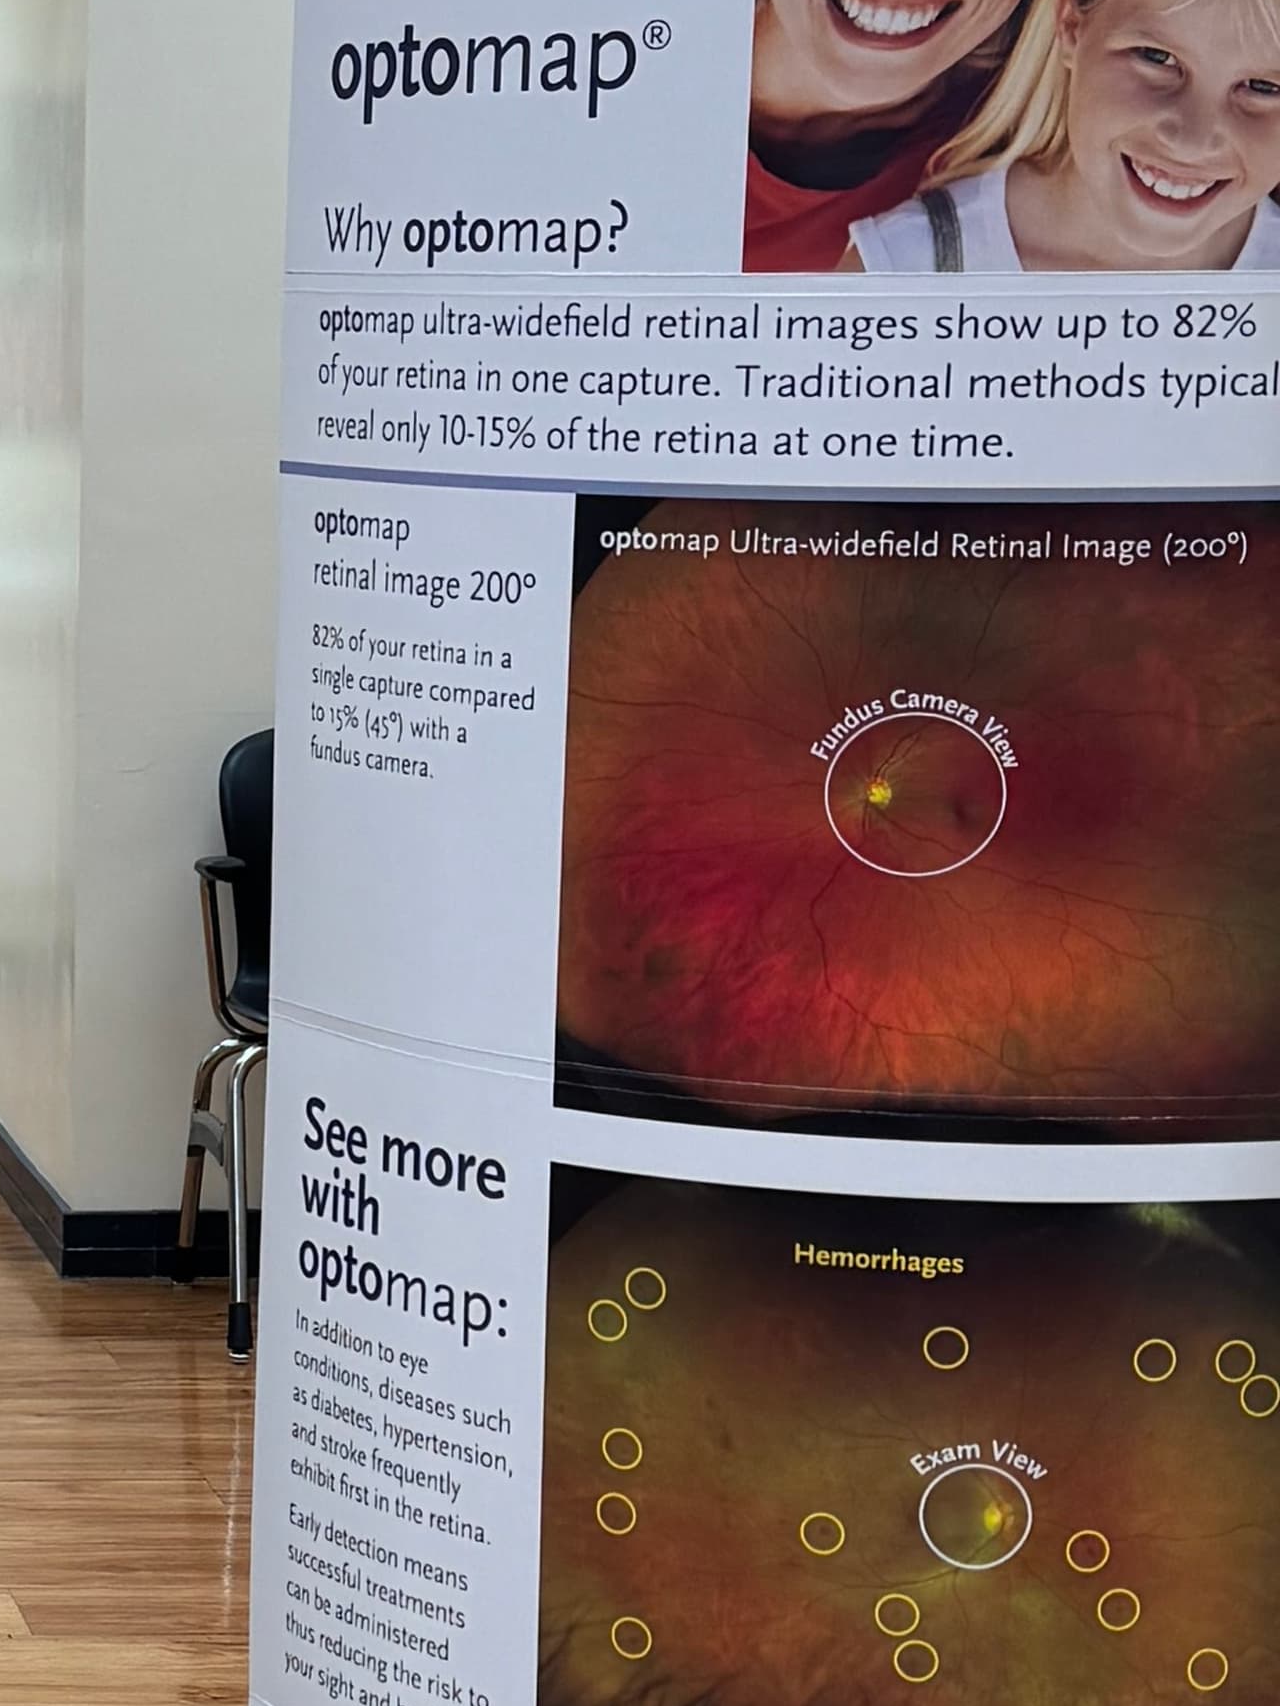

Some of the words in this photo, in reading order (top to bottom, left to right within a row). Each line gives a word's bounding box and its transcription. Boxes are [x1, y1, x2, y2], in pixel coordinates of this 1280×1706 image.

[330, 17, 672, 125] optomap®
[325, 204, 392, 268] Why
[402, 199, 629, 269] optomap?
[320, 307, 414, 344] optomap
[423, 302, 631, 340] ultra-widefield
[644, 303, 759, 340] retinal
[775, 305, 919, 350] images
[935, 303, 1041, 340] show
[1057, 313, 1107, 350] up
[1121, 308, 1159, 340] to
[1173, 302, 1257, 340] 82%
[318, 352, 341, 386] of
[341, 363, 388, 395] your
[395, 359, 466, 392] retina
[477, 361, 502, 392] in
[511, 367, 568, 394] one
[579, 367, 721, 405] capture.
[735, 363, 952, 399] Traditional
[969, 362, 1146, 399] methods
[317, 409, 374, 441] reveal
[381, 410, 430, 453] only
[440, 414, 536, 450] 10-15%
[547, 416, 582, 450] of
[588, 417, 640, 452] the
[653, 422, 757, 455] retina
[773, 430, 809, 456] at
[822, 431, 897, 457] one
[911, 426, 1014, 457] time.
[314, 509, 410, 550] optomap
[599, 527, 719, 559] optomap
[730, 529, 938, 558] Ultra-widefield
[952, 531, 1050, 559] Retinal
[1063, 533, 1151, 566] Image
[313, 559, 376, 591] retinal
[384, 566, 460, 608] image
[312, 624, 344, 651] 82%
[348, 630, 364, 653] of
[369, 641, 405, 661] your
[412, 640, 466, 665] retina
[312, 664, 354, 695] single
[359, 677, 423, 700] capture
[429, 686, 535, 713] compared
[311, 701, 325, 725] to
[330, 704, 359, 732] 15%
[410, 716, 449, 741] with
[810, 699, 884, 760] Fundus
[890, 689, 979, 724] Camera
[982, 716, 1018, 768] View
[310, 734, 360, 768] fundus
[366, 751, 434, 779] camera.
[304, 1097, 367, 1164] See
[382, 1134, 506, 1199] more
[302, 1166, 379, 1235] with
[793, 1243, 964, 1279] Hemorrhages
[299, 1240, 507, 1347] optomap:
[296, 1309, 308, 1333] In
[312, 1317, 372, 1357] addition
[378, 1341, 393, 1363] to
[400, 1351, 428, 1376] eye
[294, 1348, 373, 1398] conditions,
[378, 1376, 455, 1418] diseases
[463, 1408, 511, 1435] such
[292, 1422, 316, 1443] and
[321, 1433, 366, 1466] stroke
[372, 1447, 461, 1503] frequently
[311, 1391, 377, 1437] diabetes,
[383, 1415, 513, 1477] hypertension,
[910, 1440, 982, 1478] Exam
[991, 1440, 1049, 1483] View
[340, 1473, 369, 1506] first
[374, 1489, 389, 1512] in
[396, 1497, 422, 1524] the
[430, 1513, 491, 1544] retina.
[290, 1503, 320, 1542] Early
[325, 1522, 398, 1567] detection
[404, 1557, 468, 1591] means
[288, 1544, 361, 1592] successful
[366, 1578, 465, 1628] treatments
[286, 1613, 315, 1642] thus
[320, 1634, 388, 1682] reducing
[393, 1662, 421, 1689] the
[427, 1676, 462, 1704] risk
[335, 1604, 449, 1661] administered
[285, 1652, 313, 1680] your
[319, 1668, 354, 1699] sight
